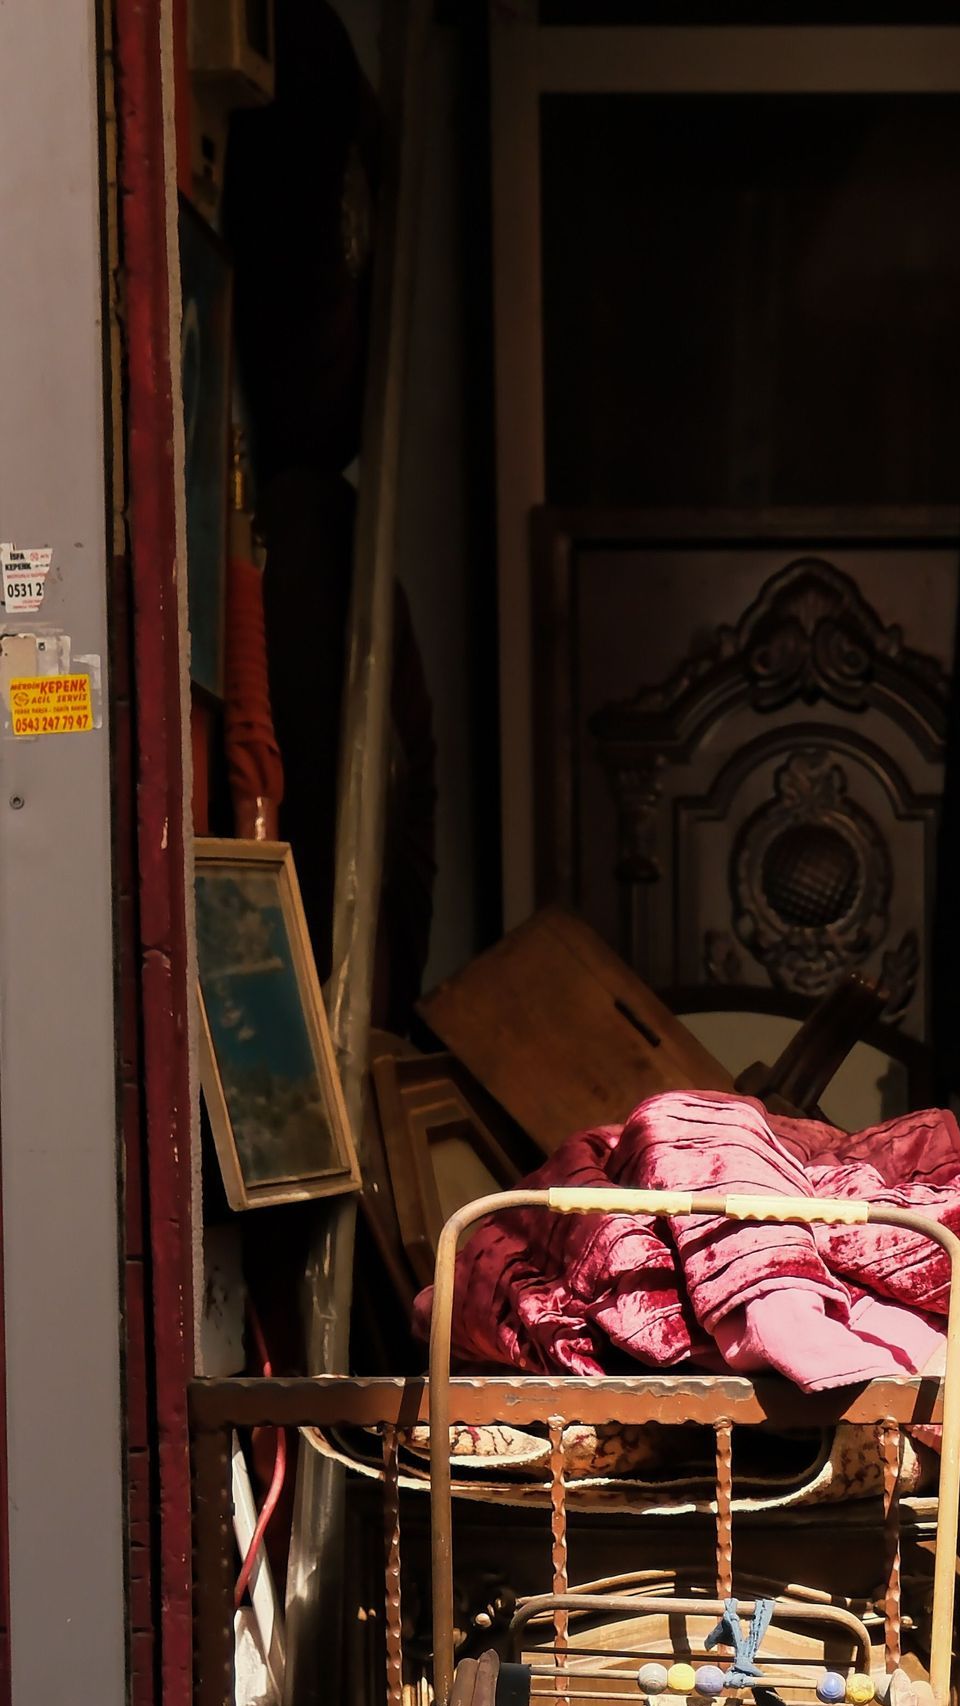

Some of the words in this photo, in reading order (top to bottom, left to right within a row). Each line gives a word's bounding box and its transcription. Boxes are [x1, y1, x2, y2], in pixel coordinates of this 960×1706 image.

[5, 562, 31, 571] KEPENK
[7, 583, 33, 598] 0531
[36, 582, 45, 597] 2
[39, 679, 87, 695] KEPENK
[15, 717, 40, 733] 0543
[42, 715, 60, 731] 247
[62, 714, 74, 730] 79
[76, 713, 88, 729] 47
